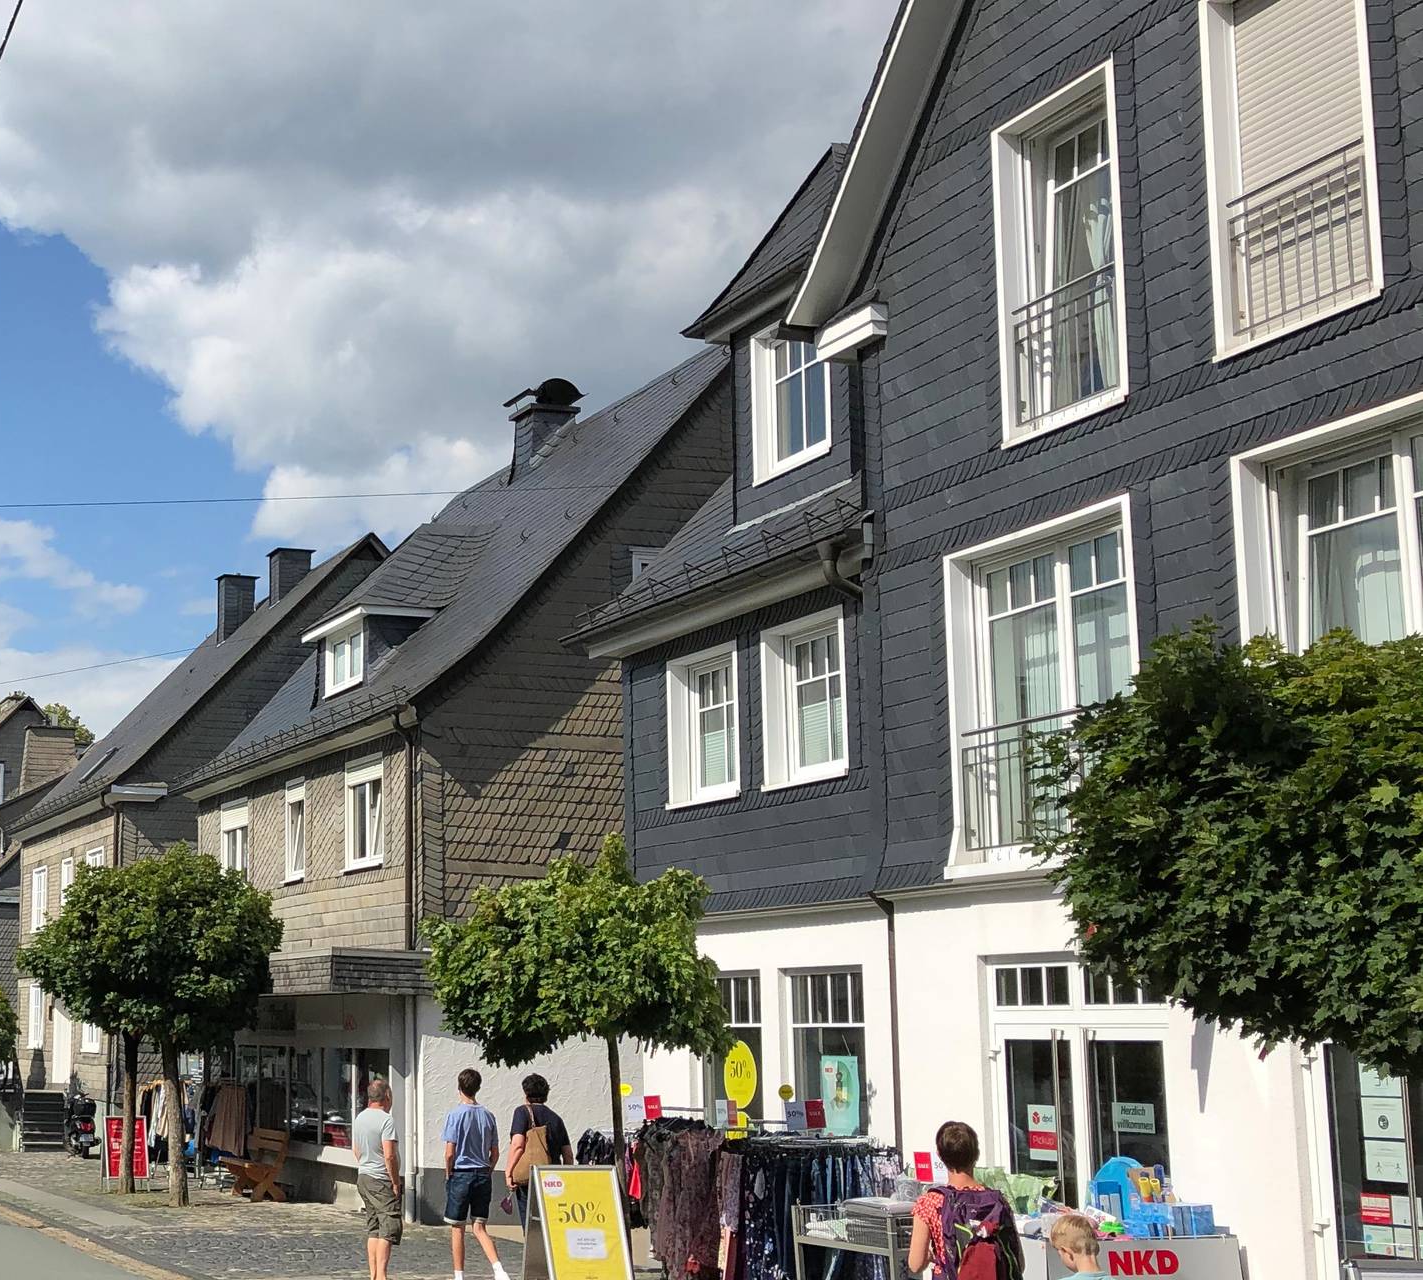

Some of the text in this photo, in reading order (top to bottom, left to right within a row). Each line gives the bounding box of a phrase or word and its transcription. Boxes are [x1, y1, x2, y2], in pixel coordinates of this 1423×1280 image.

[730, 1060, 751, 1079] 50%
[1120, 1105, 1146, 1116] Herzlich
[1042, 1114, 1053, 1125] dpd
[544, 1180, 563, 1188] NKD
[557, 1201, 606, 1224] 50%
[1108, 1249, 1180, 1276] NKD
